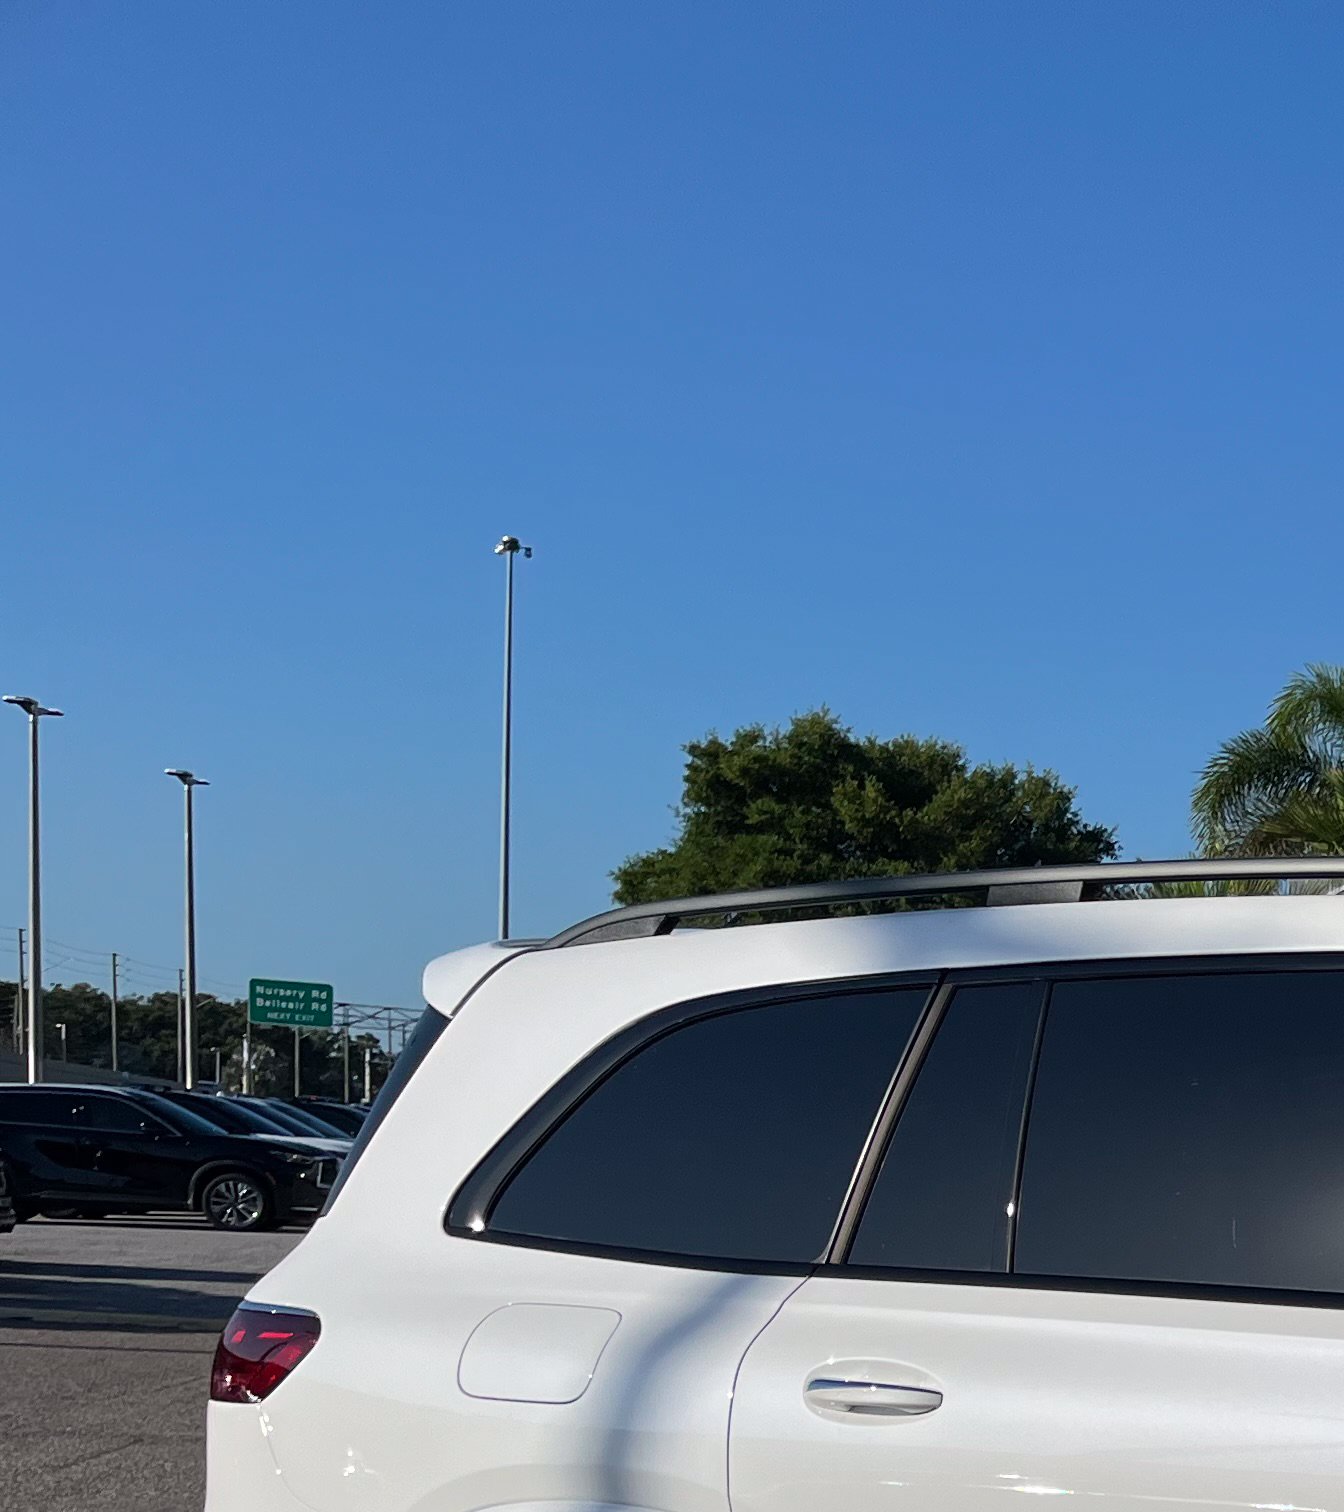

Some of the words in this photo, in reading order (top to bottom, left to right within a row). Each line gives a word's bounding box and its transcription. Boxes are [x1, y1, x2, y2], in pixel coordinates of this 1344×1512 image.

[256, 985, 305, 999] Nursery
[311, 989, 328, 1000] Rd
[311, 1002, 328, 1012] Rd
